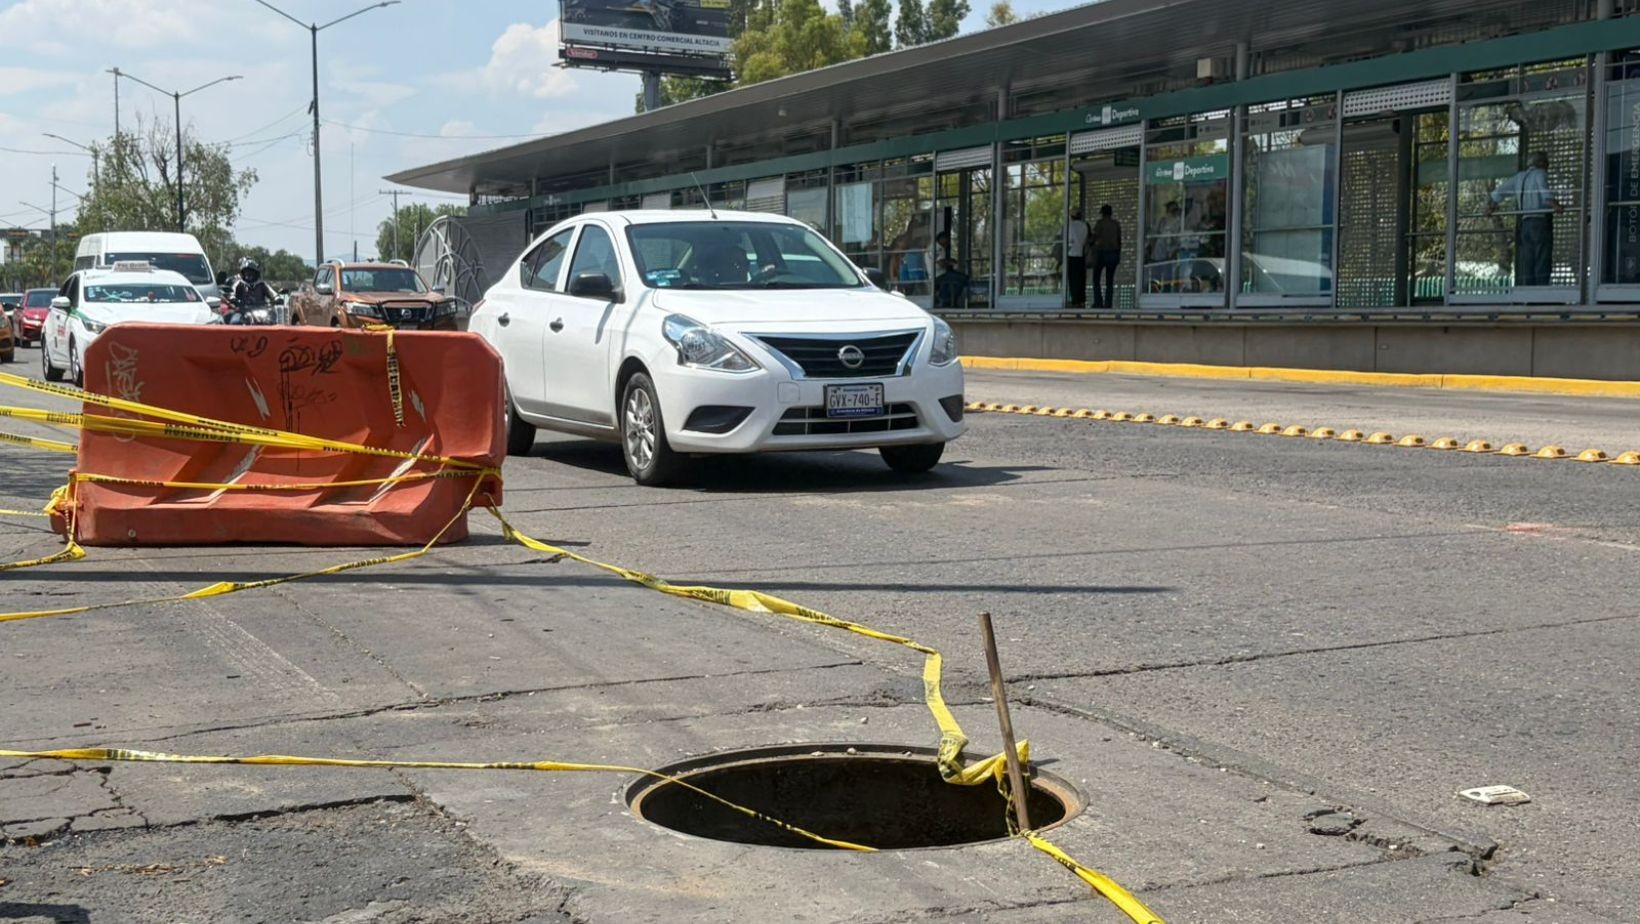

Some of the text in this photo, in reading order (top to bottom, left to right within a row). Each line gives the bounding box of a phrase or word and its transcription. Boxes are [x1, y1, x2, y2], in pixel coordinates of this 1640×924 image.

[619, 31, 628, 39] EN
[629, 33, 656, 41] CENTRO
[657, 35, 693, 44] COMERCIAL
[695, 38, 720, 46] ALTACIA
[1629, 102, 1640, 179] EMERGENCIA
[1184, 163, 1214, 178] Deportiva
[1629, 181, 1639, 197] DE
[829, 393, 880, 408] GVX-740-E
